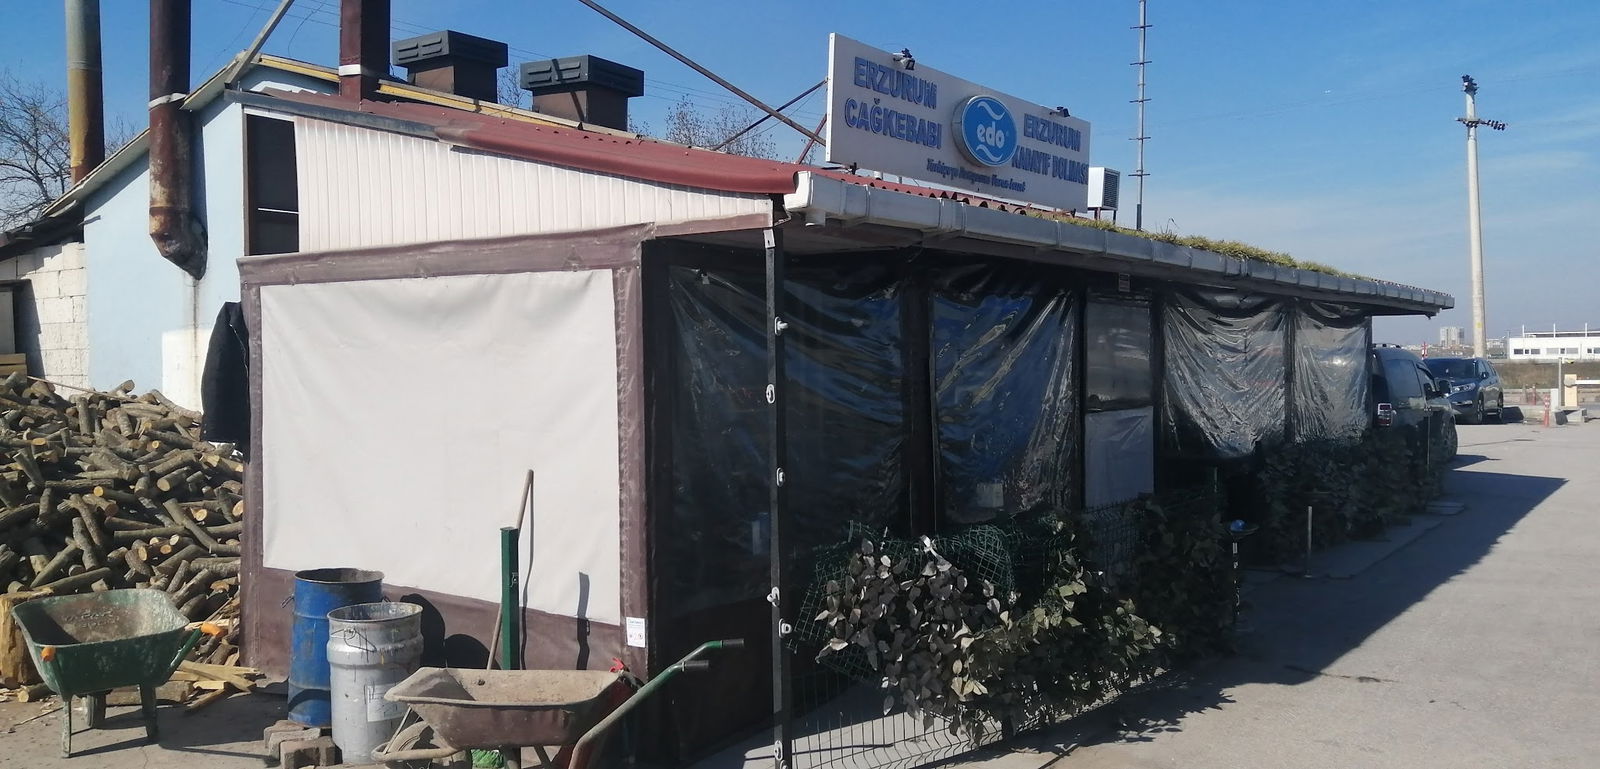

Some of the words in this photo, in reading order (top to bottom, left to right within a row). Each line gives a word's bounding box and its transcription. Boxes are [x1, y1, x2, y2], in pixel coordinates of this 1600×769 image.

[853, 56, 938, 110] ERZURUM
[976, 121, 1005, 149] edo
[1023, 112, 1081, 153] ERZURUM
